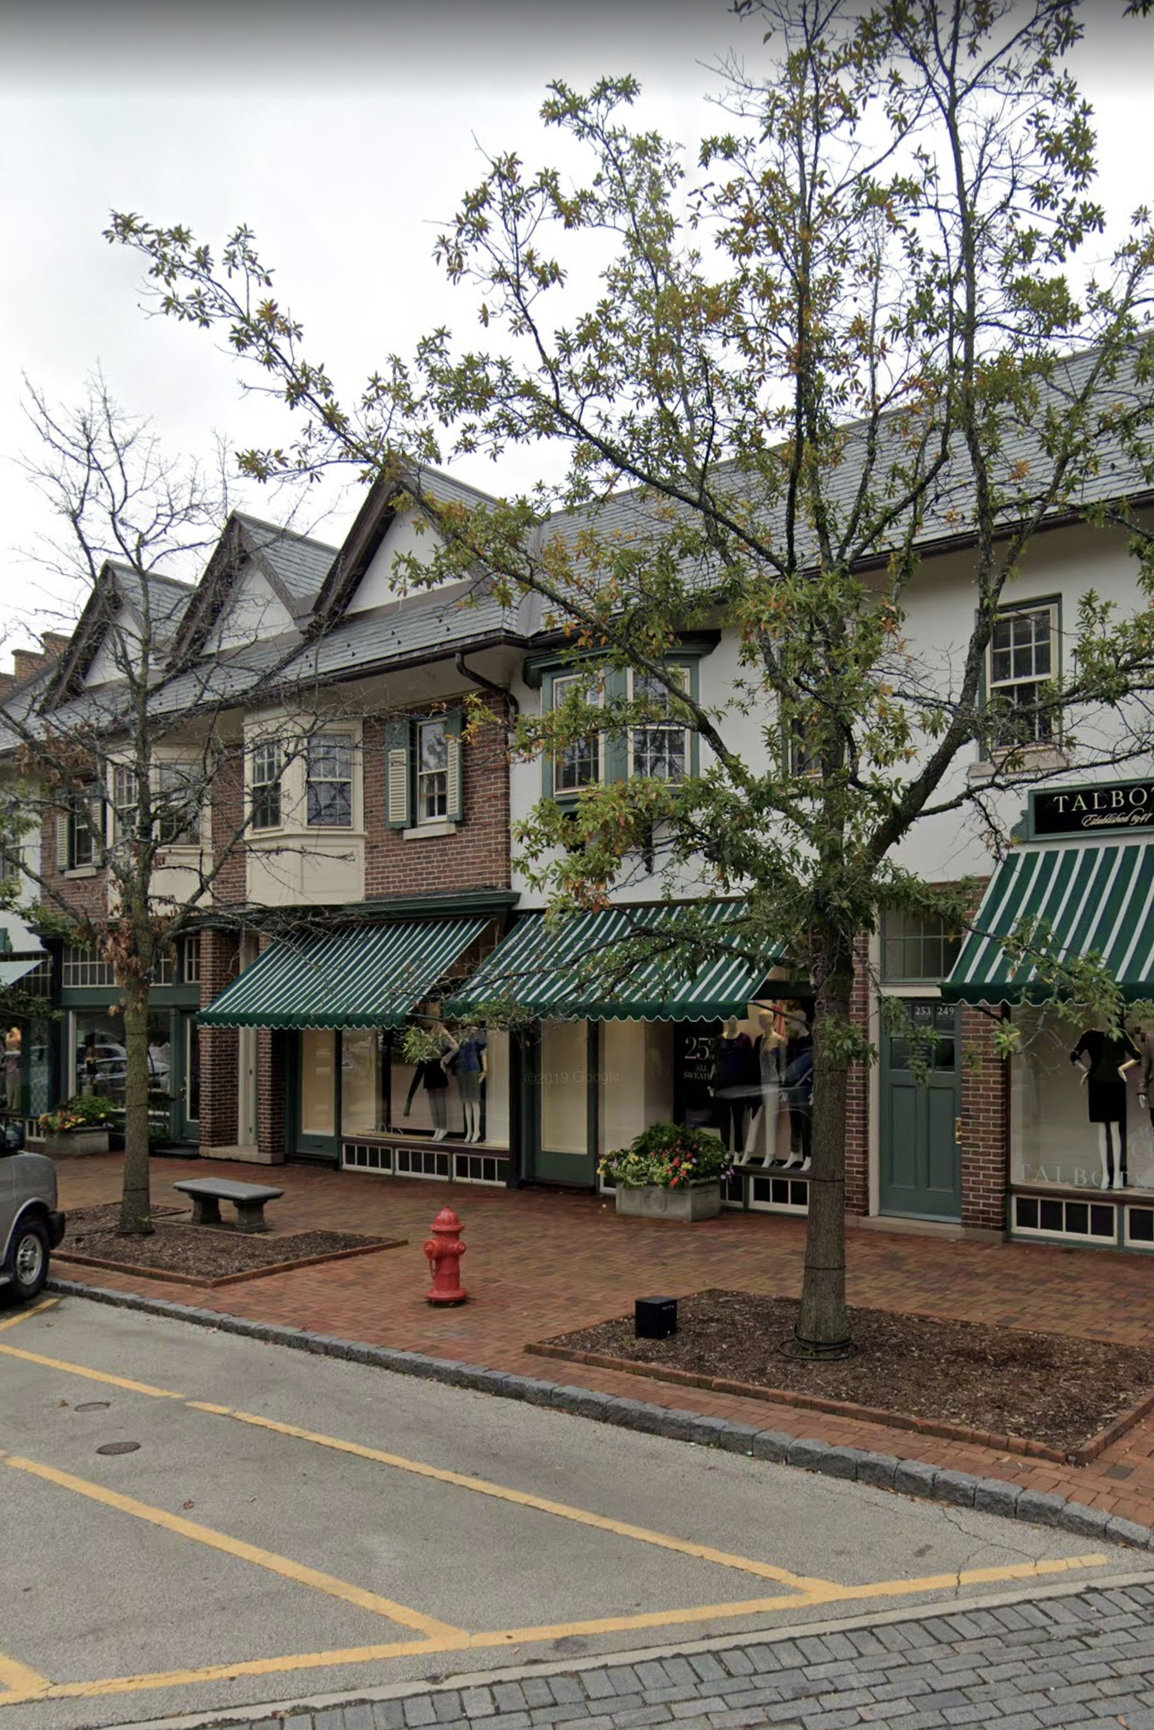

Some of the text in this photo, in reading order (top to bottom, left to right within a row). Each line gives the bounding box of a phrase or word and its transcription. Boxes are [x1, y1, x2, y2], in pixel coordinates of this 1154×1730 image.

[1081, 807, 1145, 828] Established
[914, 1006, 931, 1016] 253
[937, 1006, 955, 1016] 249
